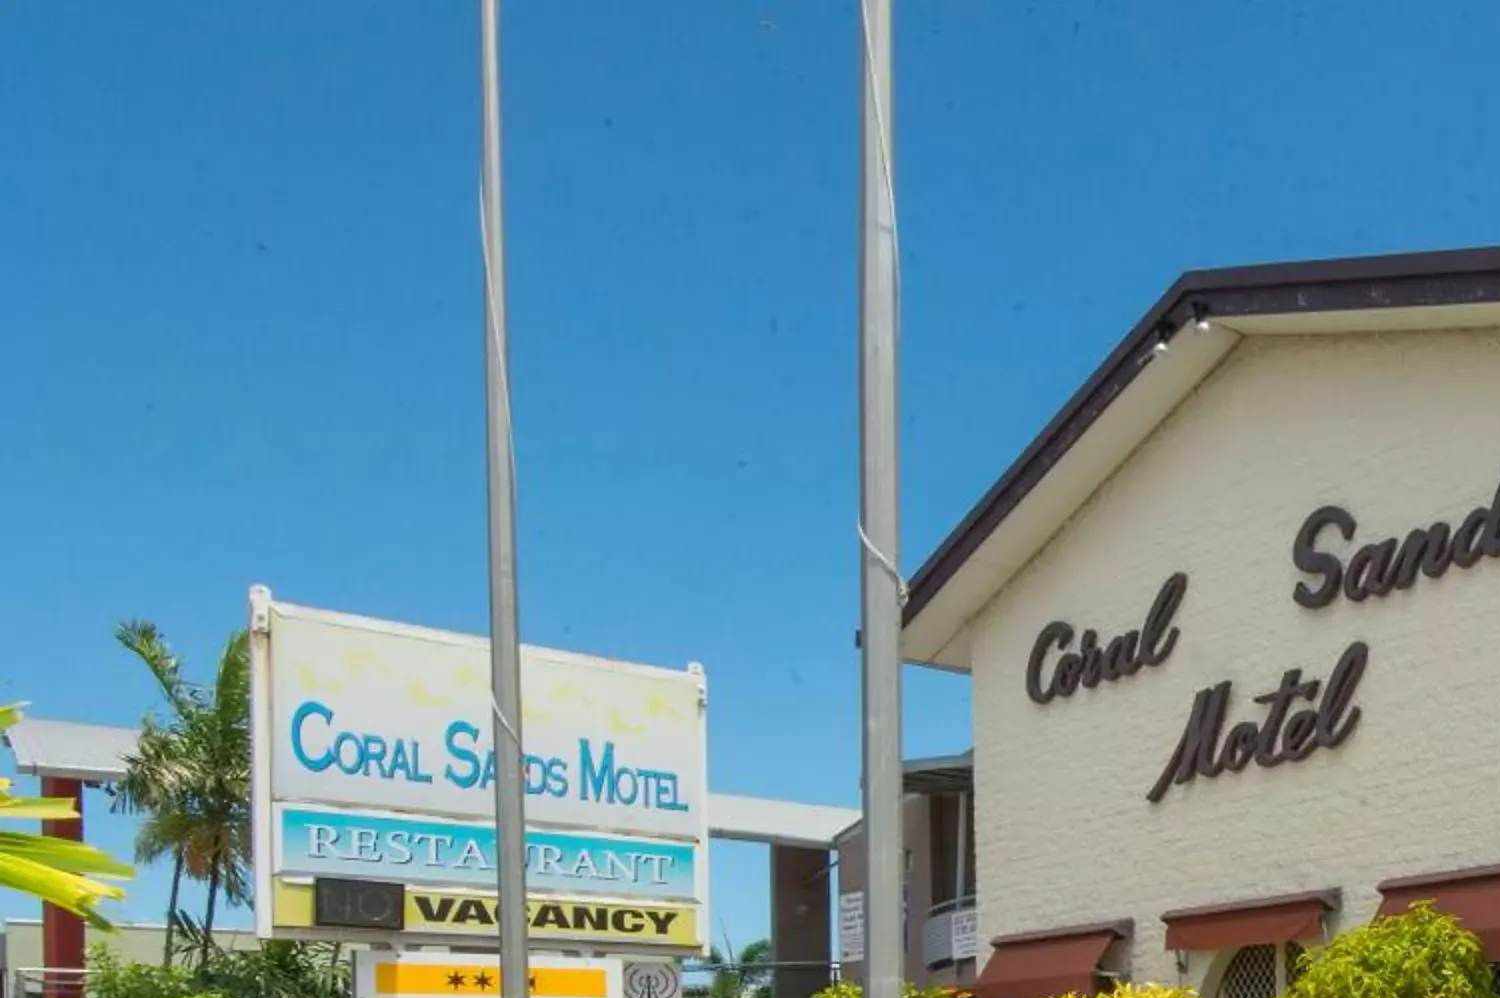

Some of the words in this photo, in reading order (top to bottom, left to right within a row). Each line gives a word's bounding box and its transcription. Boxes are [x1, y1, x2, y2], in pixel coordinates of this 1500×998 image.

[1026, 571, 1188, 704] Coral
[291, 700, 433, 784] CORAL
[444, 719, 568, 798] SADS
[577, 737, 690, 813] MOTEL
[1146, 640, 1369, 803] Motel
[303, 823, 675, 886] RESTARANT
[414, 896, 680, 936] VAANCY
